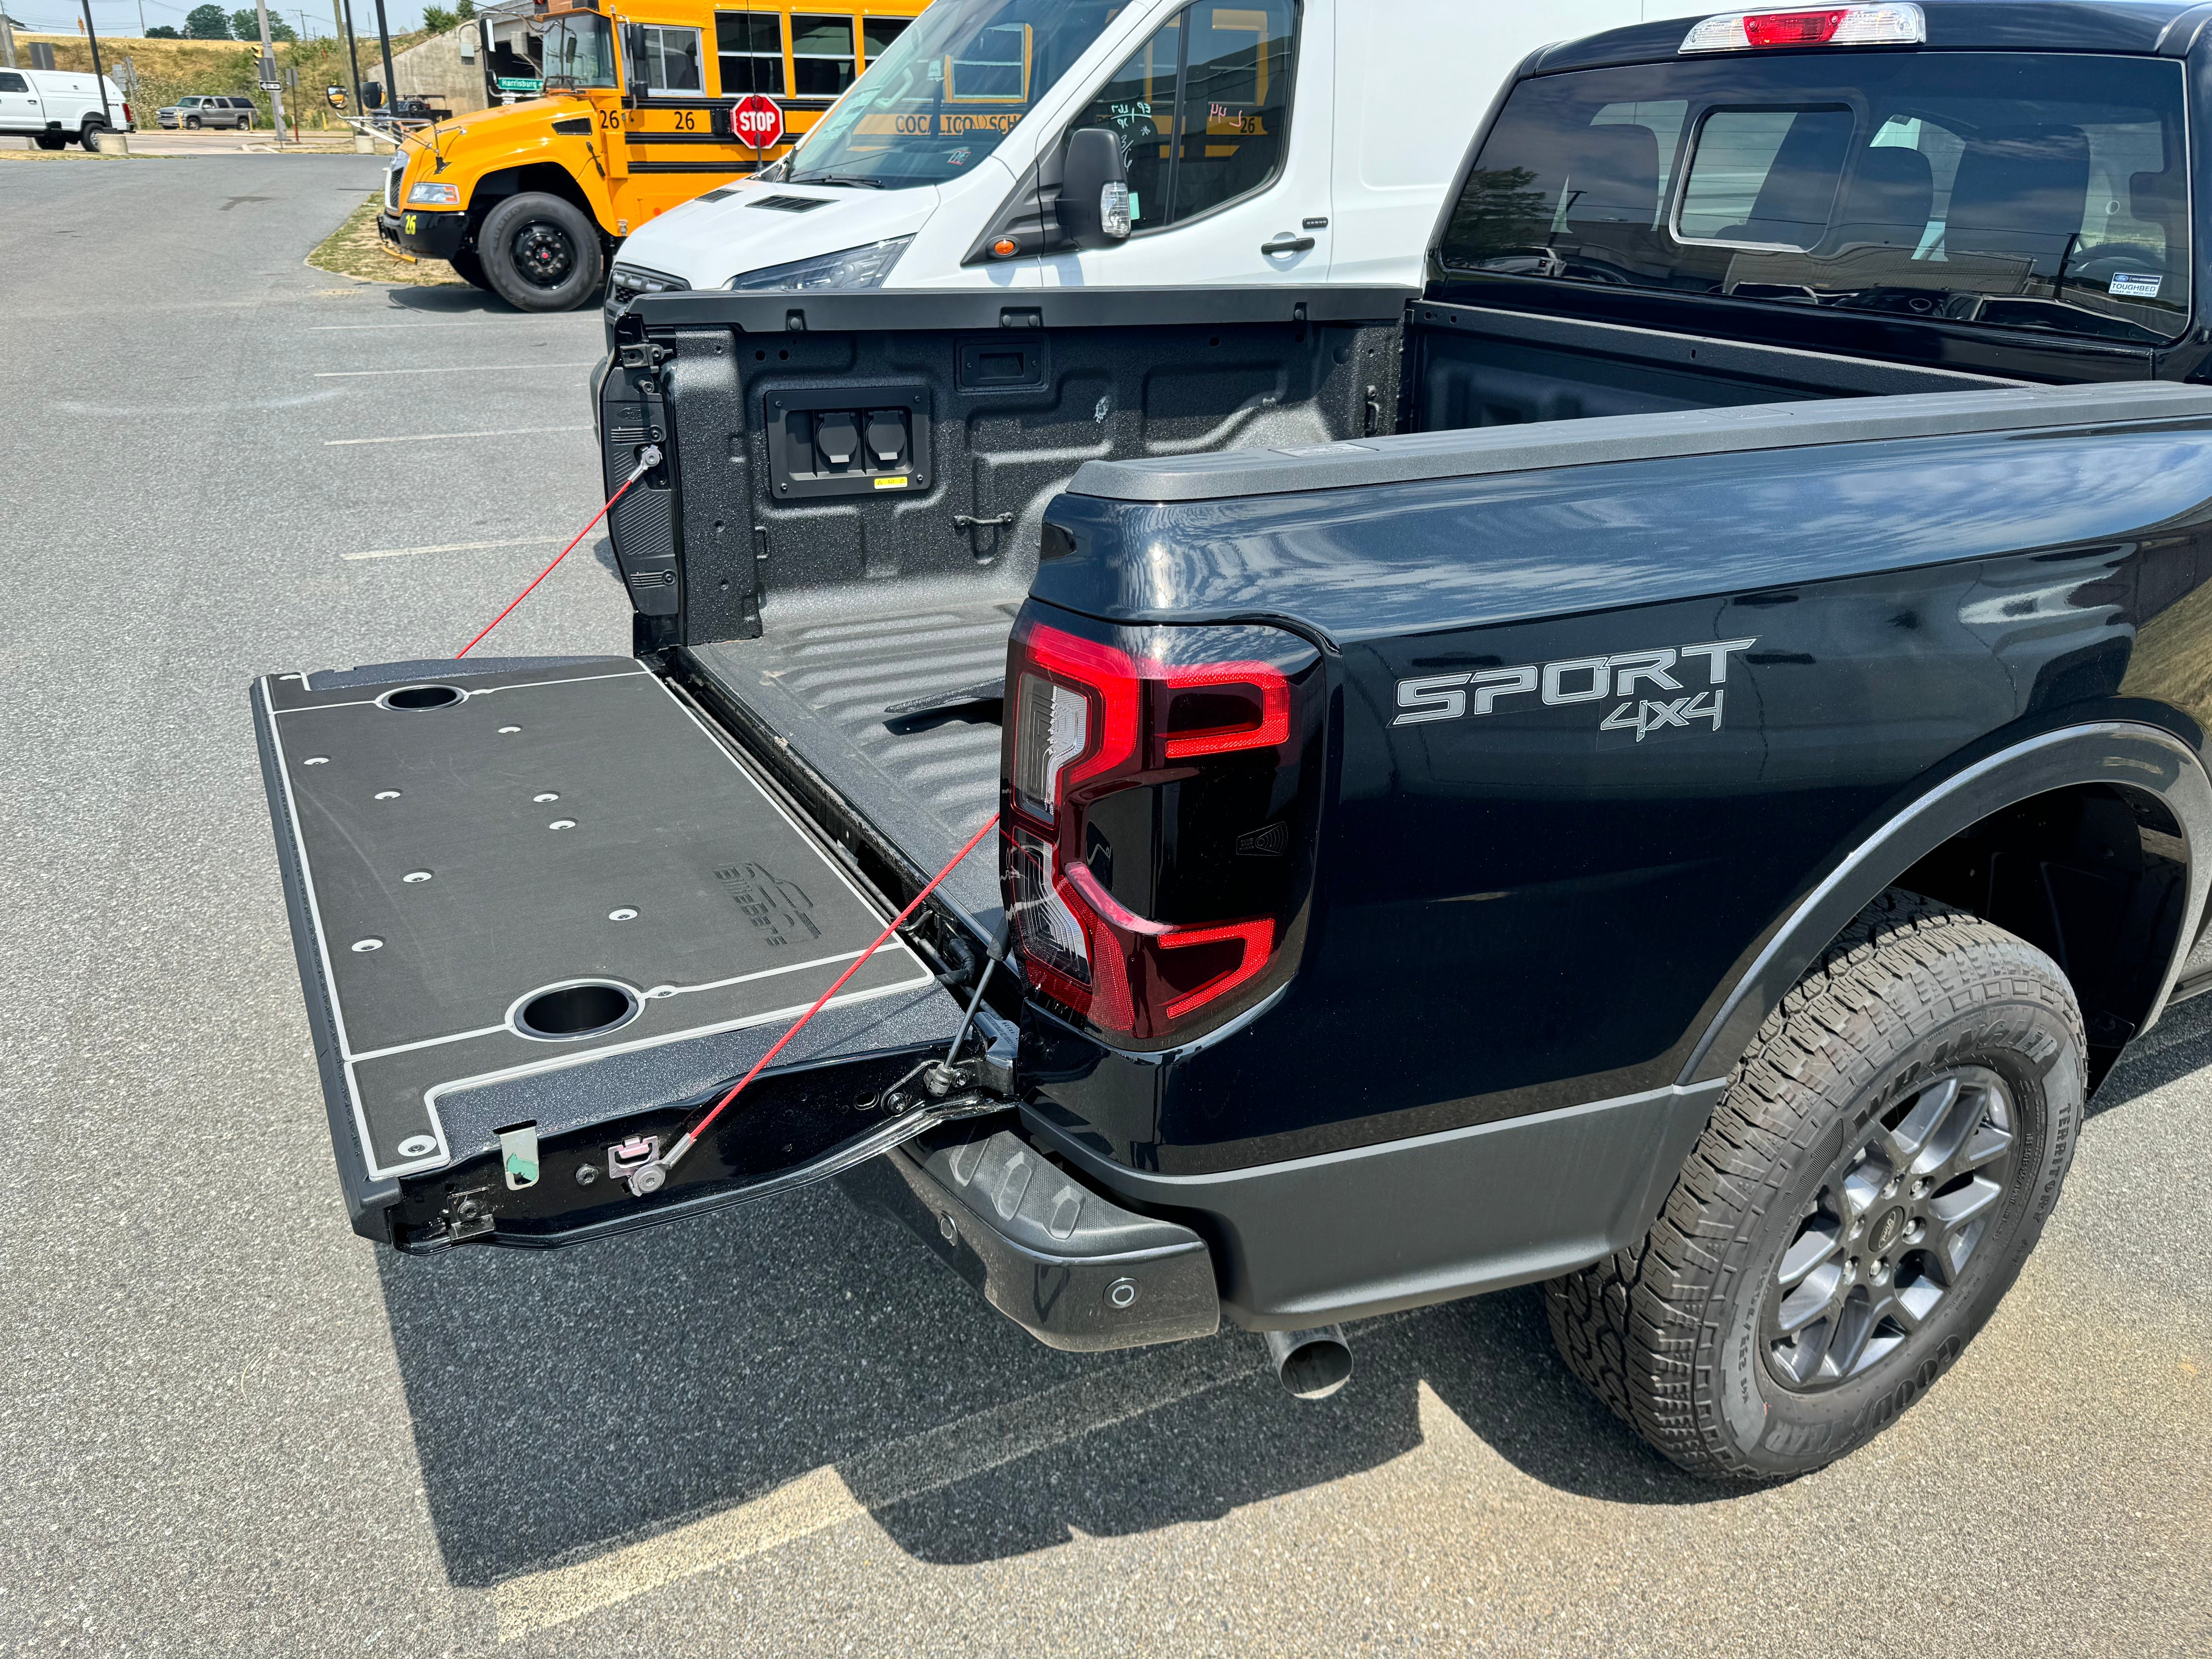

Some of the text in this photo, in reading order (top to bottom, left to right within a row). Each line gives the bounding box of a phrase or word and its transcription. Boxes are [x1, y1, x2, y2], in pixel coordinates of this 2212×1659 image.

[501, 80, 537, 89] Harrisburg
[600, 110, 620, 129] 26
[674, 111, 695, 130] 26
[740, 111, 776, 132] STOP
[1240, 117, 1255, 134] 26
[405, 215, 417, 235] 26
[2112, 283, 2156, 292] TOUGHBED
[1393, 639, 1756, 725] SPORT
[2033, 1103, 2071, 1223] TERRITORY
[1764, 1334, 1961, 1458] GOODYEAR
